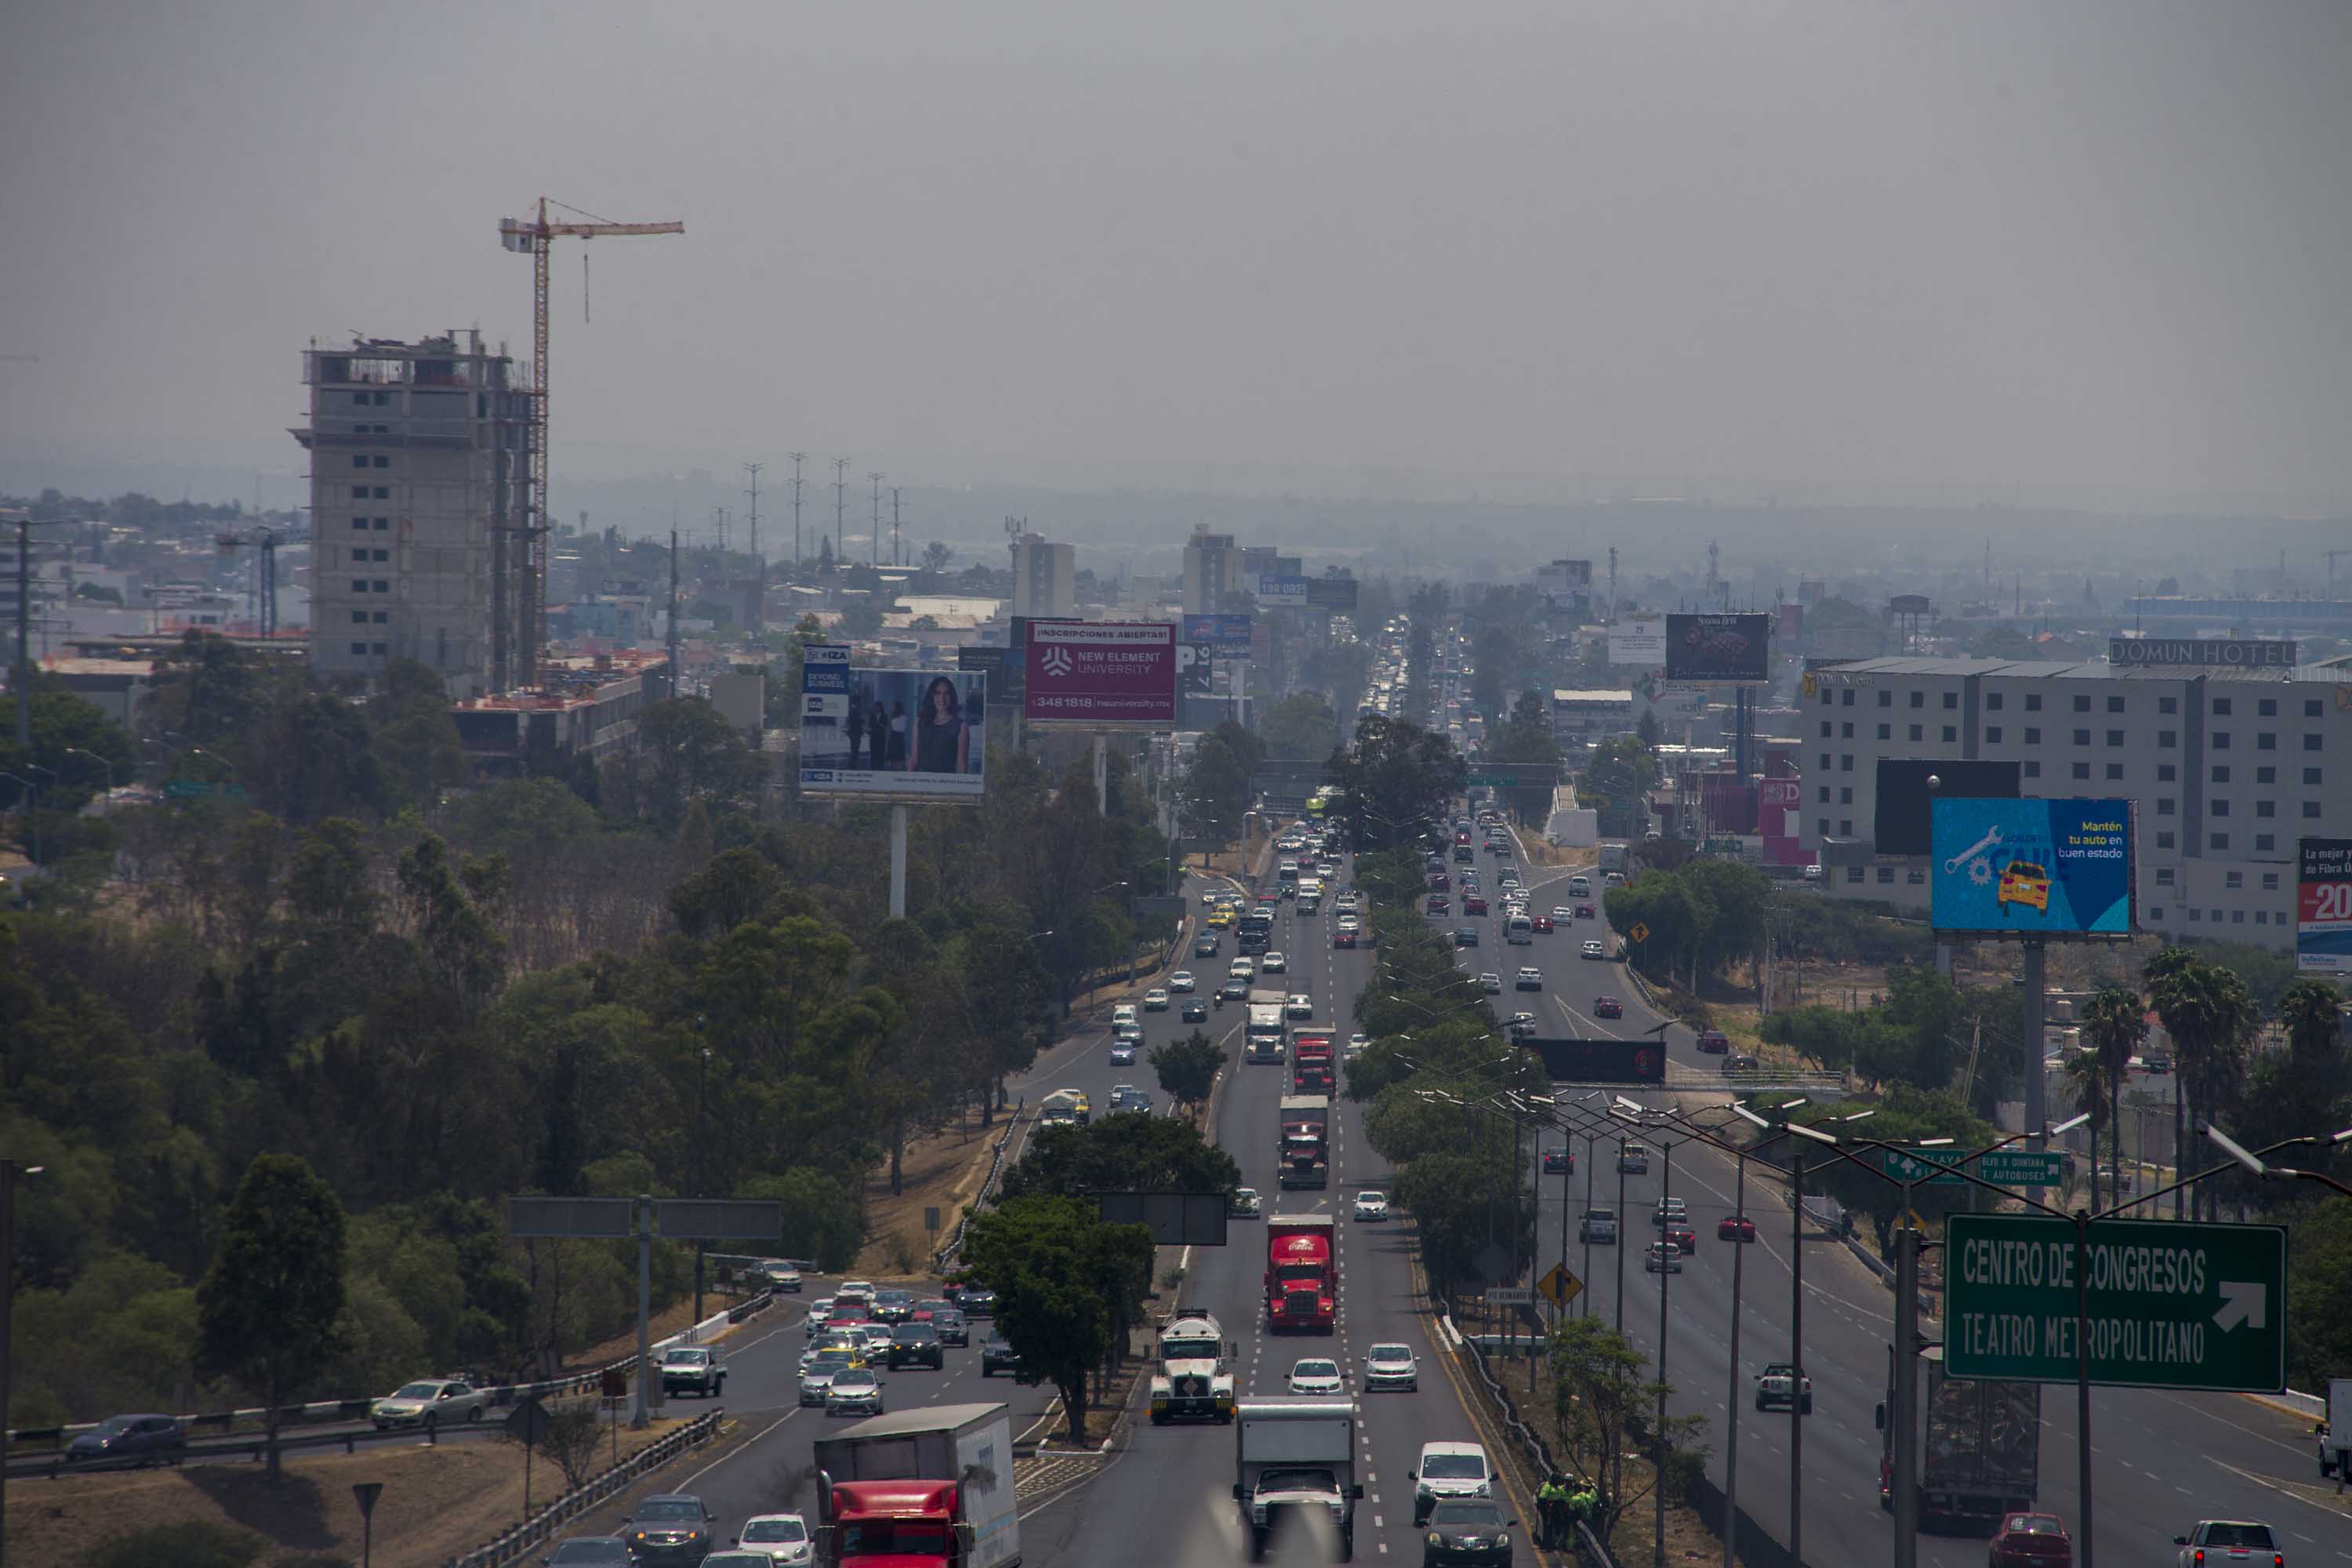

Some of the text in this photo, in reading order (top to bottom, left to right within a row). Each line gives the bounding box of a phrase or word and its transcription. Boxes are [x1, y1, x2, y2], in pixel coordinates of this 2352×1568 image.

[1037, 629, 1167, 640] ¡INSCRIPCIONES ABIERTAS!
[1078, 652, 1161, 662] NEW ELEMENT
[2111, 641, 2293, 664] DOMUN HOTEL
[1078, 663, 1152, 674] UNIVERSITY
[2082, 821, 2123, 832] Mantén
[2069, 836, 2123, 846] tu auto en
[2058, 848, 2123, 858] buen estado
[2305, 848, 2316, 859] La
[2318, 848, 2345, 861] mejor
[2305, 863, 2317, 873] de
[2318, 863, 2342, 874] Fibra
[1982, 1169, 2045, 1180] T AUTOBUSES
[1962, 1237, 2043, 1287] CENTRO
[2049, 1243, 2074, 1288] DE
[1962, 1312, 2205, 1365] TEATRO METROPOLITANO
